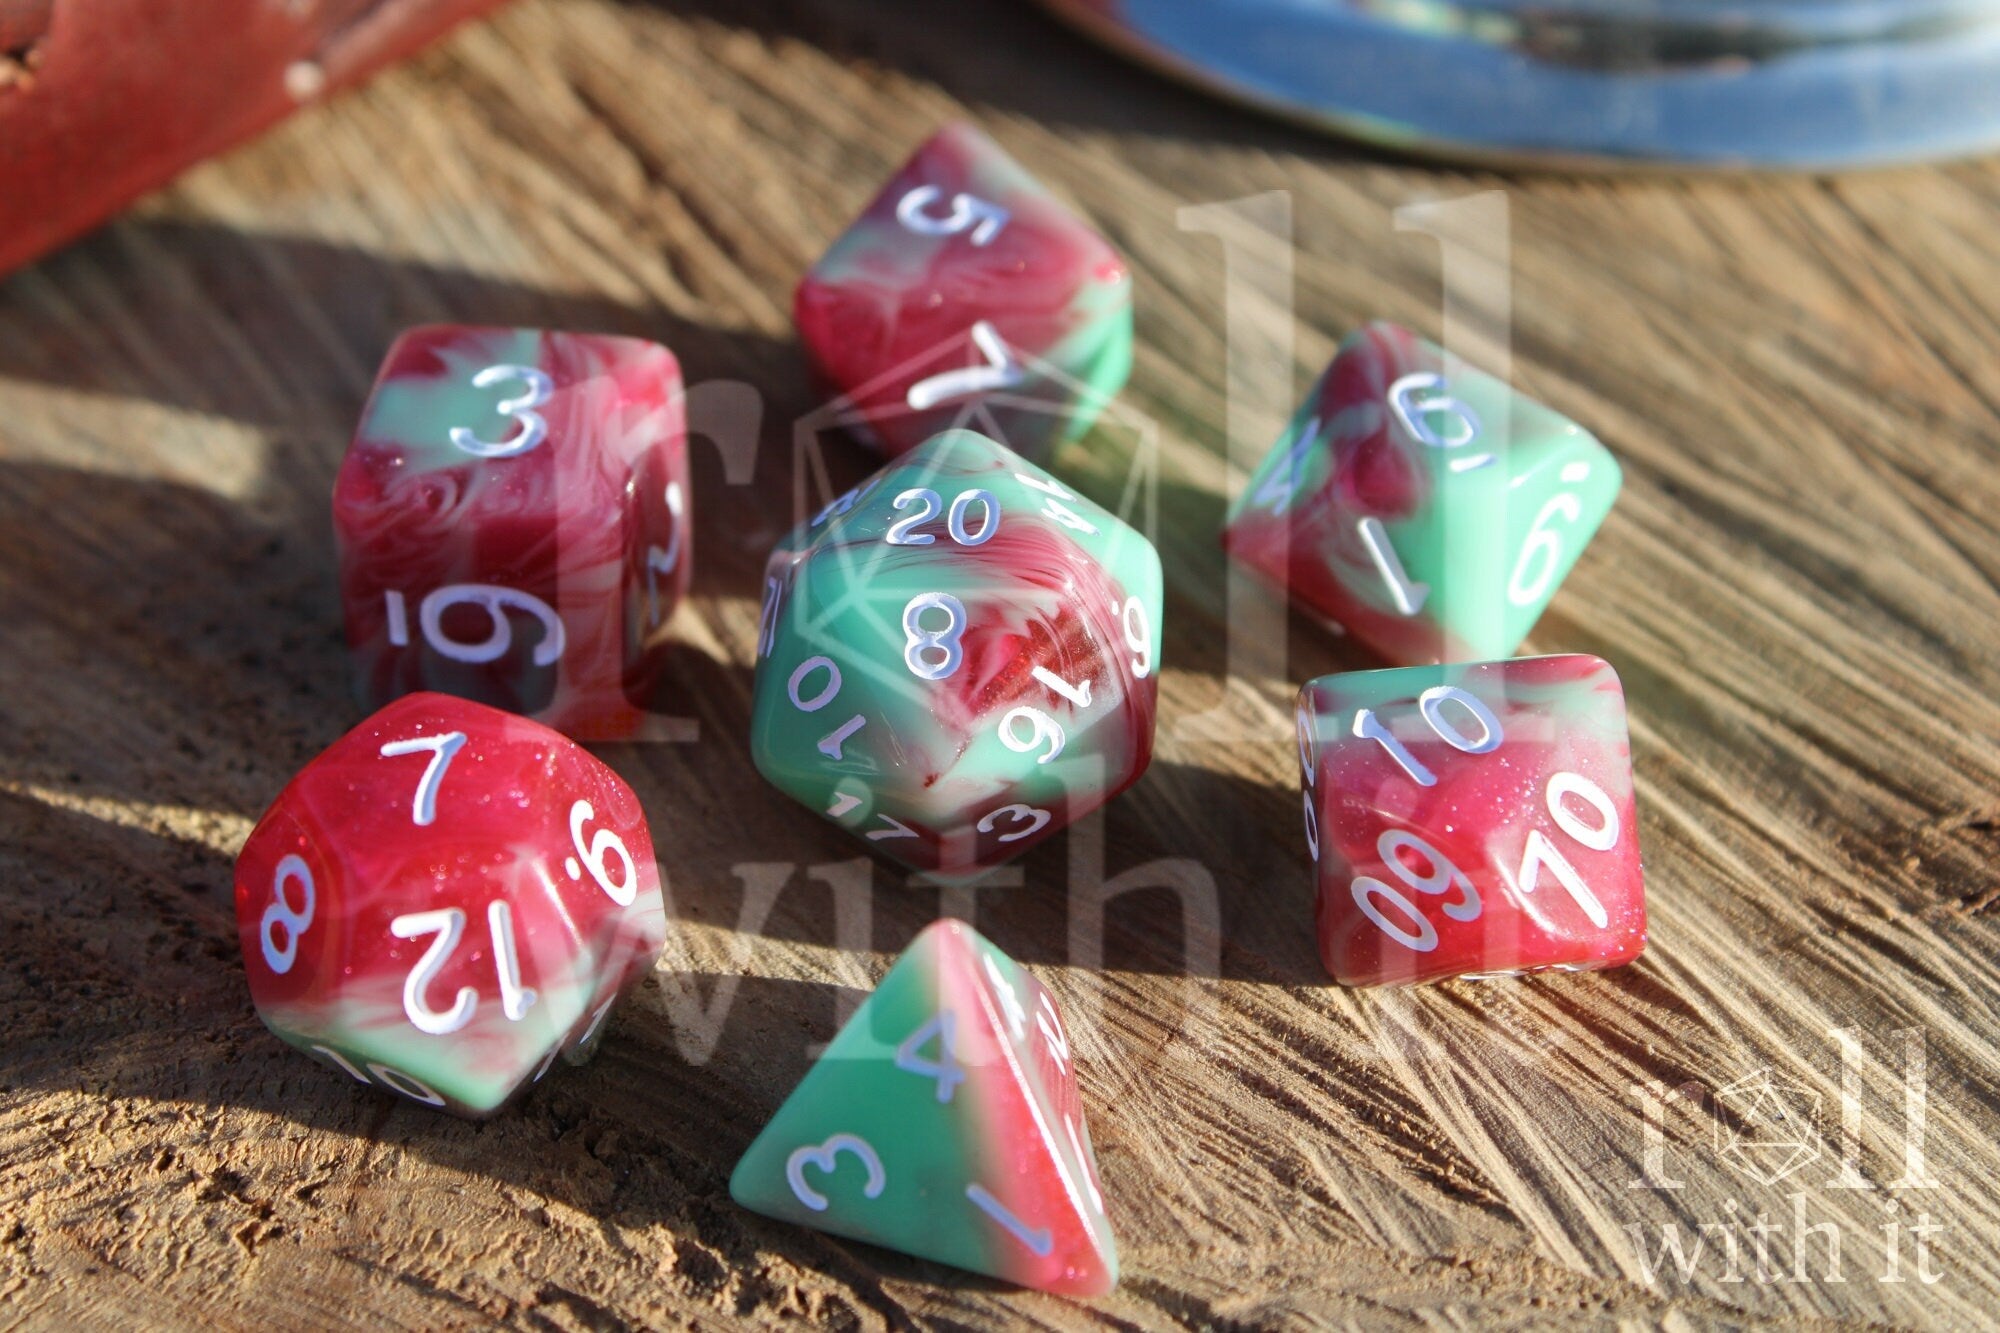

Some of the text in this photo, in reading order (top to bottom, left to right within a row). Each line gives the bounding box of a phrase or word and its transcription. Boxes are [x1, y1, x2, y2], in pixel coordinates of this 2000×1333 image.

[896, 184, 1010, 247] 5
[449, 364, 553, 458] 3
[886, 488, 1000, 546] 20
[1358, 517, 1430, 615] 1
[903, 592, 967, 679] 8
[380, 732, 467, 826] 7
[1353, 686, 1504, 786] 10
[977, 803, 1052, 842] 3
[1519, 772, 1619, 928] 70
[261, 854, 316, 974] 8
[391, 898, 537, 1035] 12
[895, 1009, 966, 1104] 4
[786, 1133, 886, 1212] 3
[965, 1182, 1053, 1256] 1
